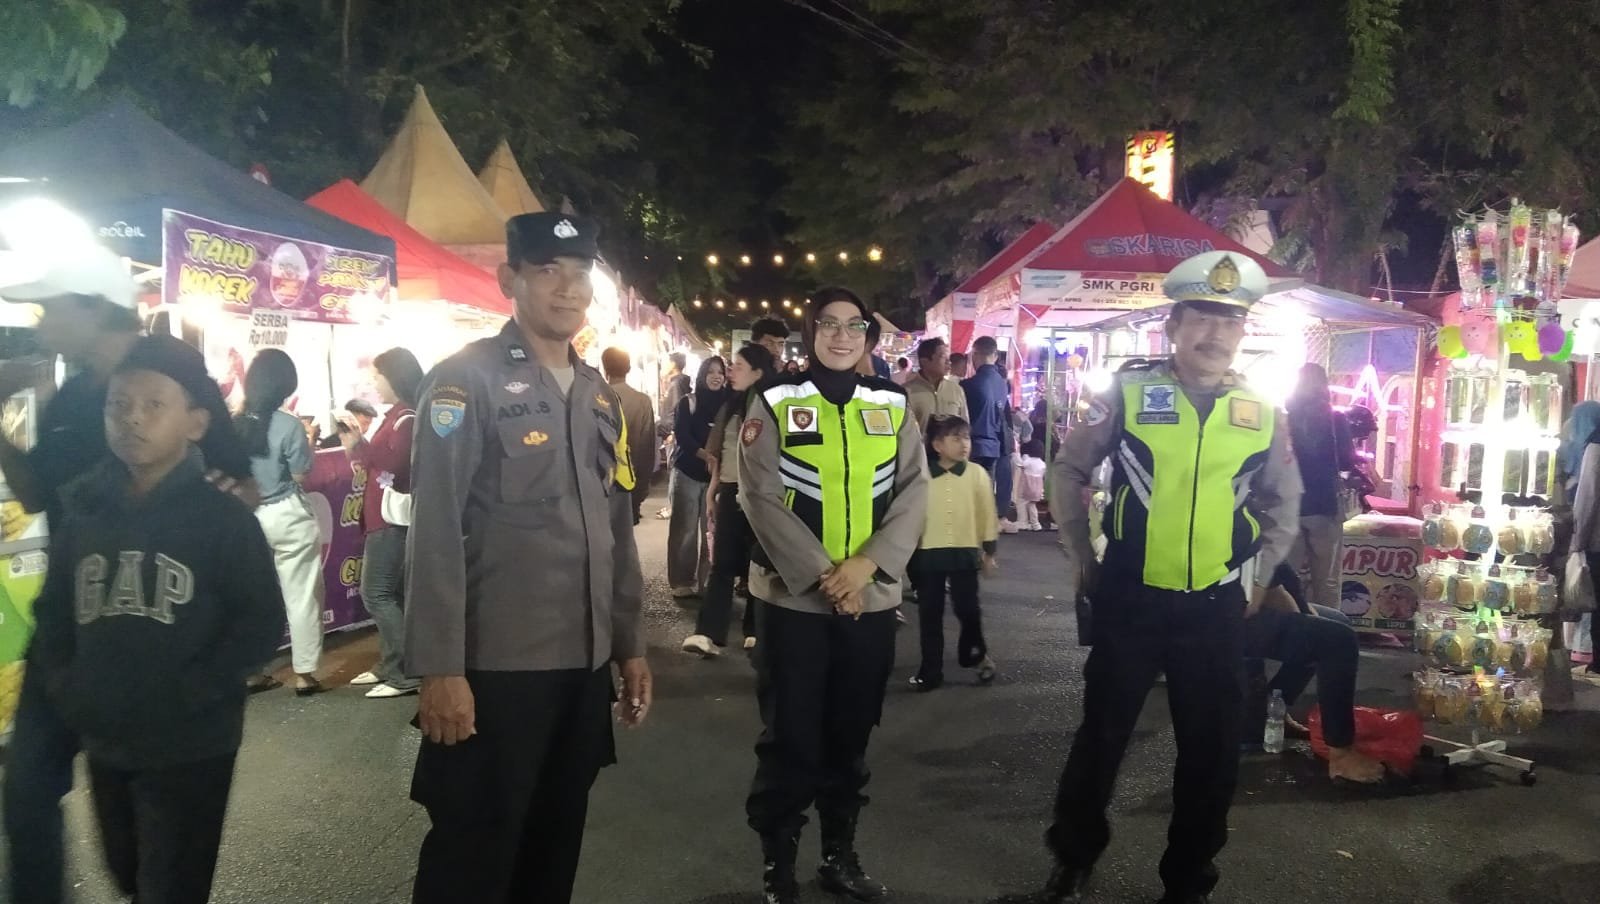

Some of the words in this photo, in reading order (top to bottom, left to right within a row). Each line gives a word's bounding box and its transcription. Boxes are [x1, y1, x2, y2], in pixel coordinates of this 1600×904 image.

[185, 230, 256, 270] TAHU
[1082, 280, 1114, 290] SMK
[1120, 281, 1154, 292] PGRI
[254, 313, 288, 328] SERBA
[75, 551, 195, 625] GAP
